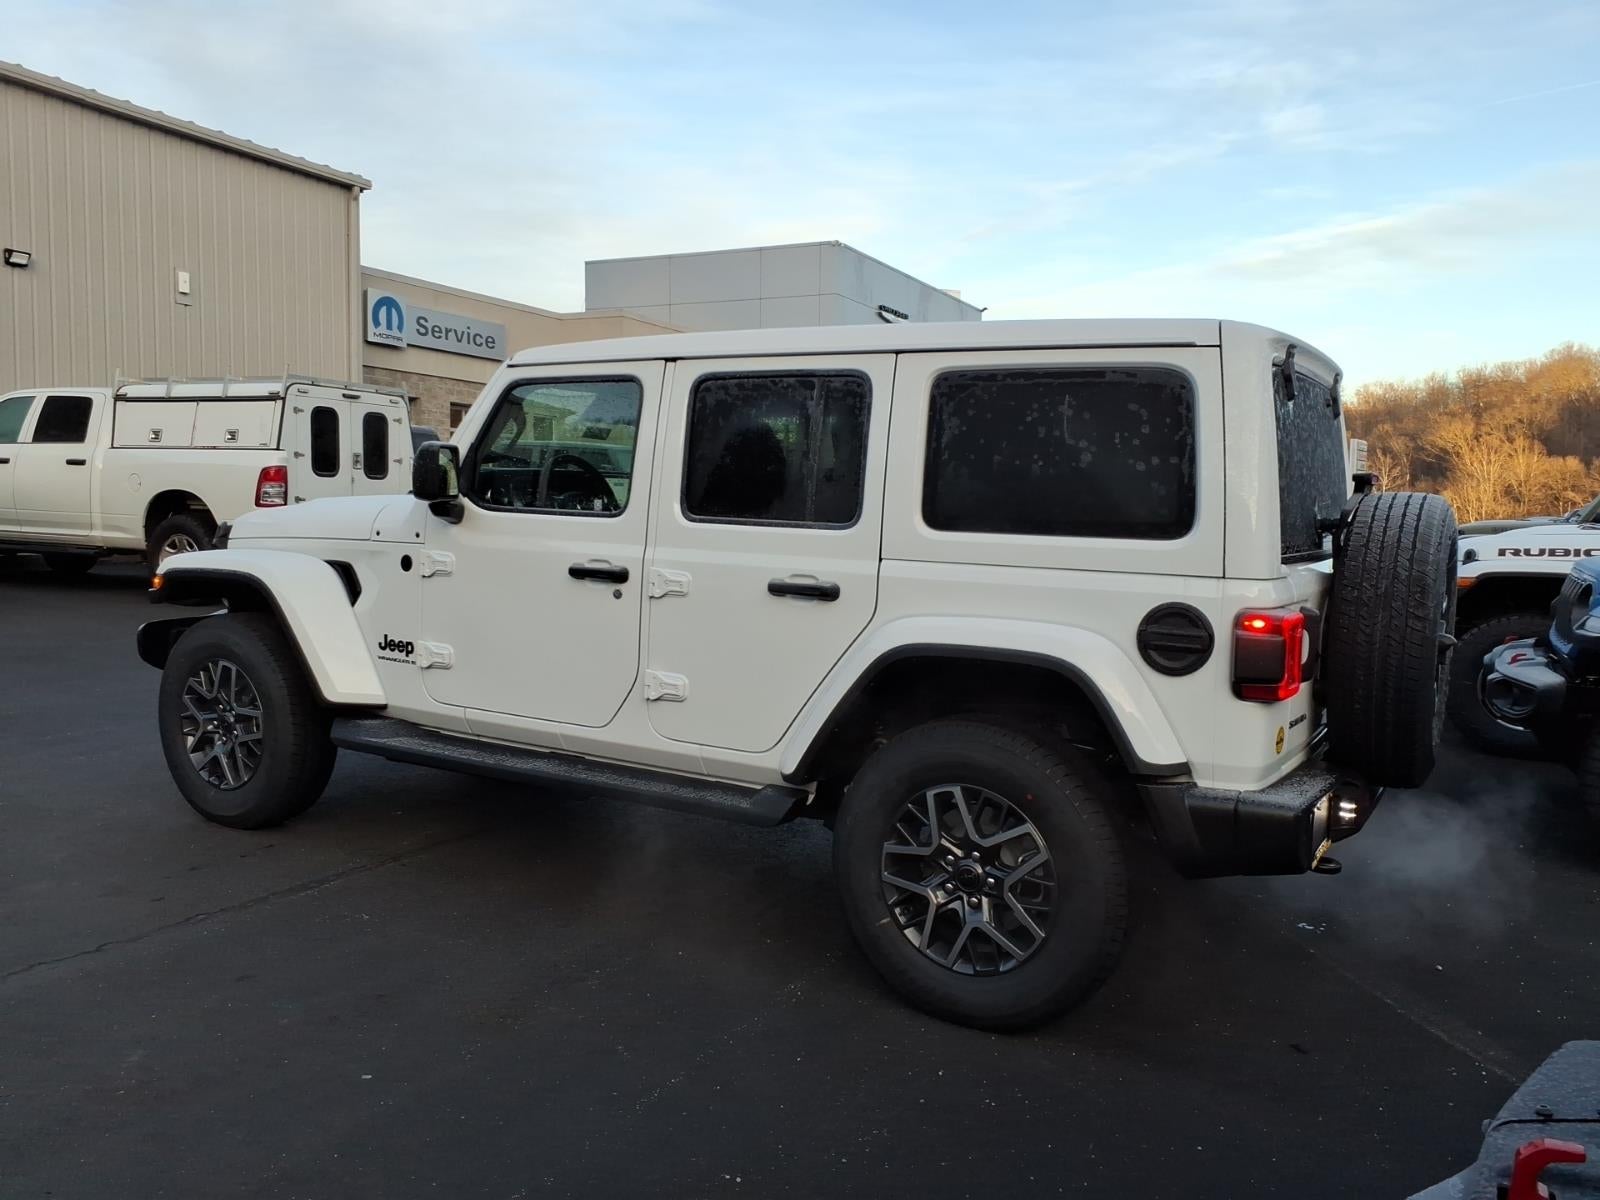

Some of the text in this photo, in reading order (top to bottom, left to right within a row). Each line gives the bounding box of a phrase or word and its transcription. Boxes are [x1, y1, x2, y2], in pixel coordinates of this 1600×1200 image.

[372, 331, 404, 343] MOPAR
[415, 315, 496, 350] Service
[378, 633, 415, 657] Jeep
